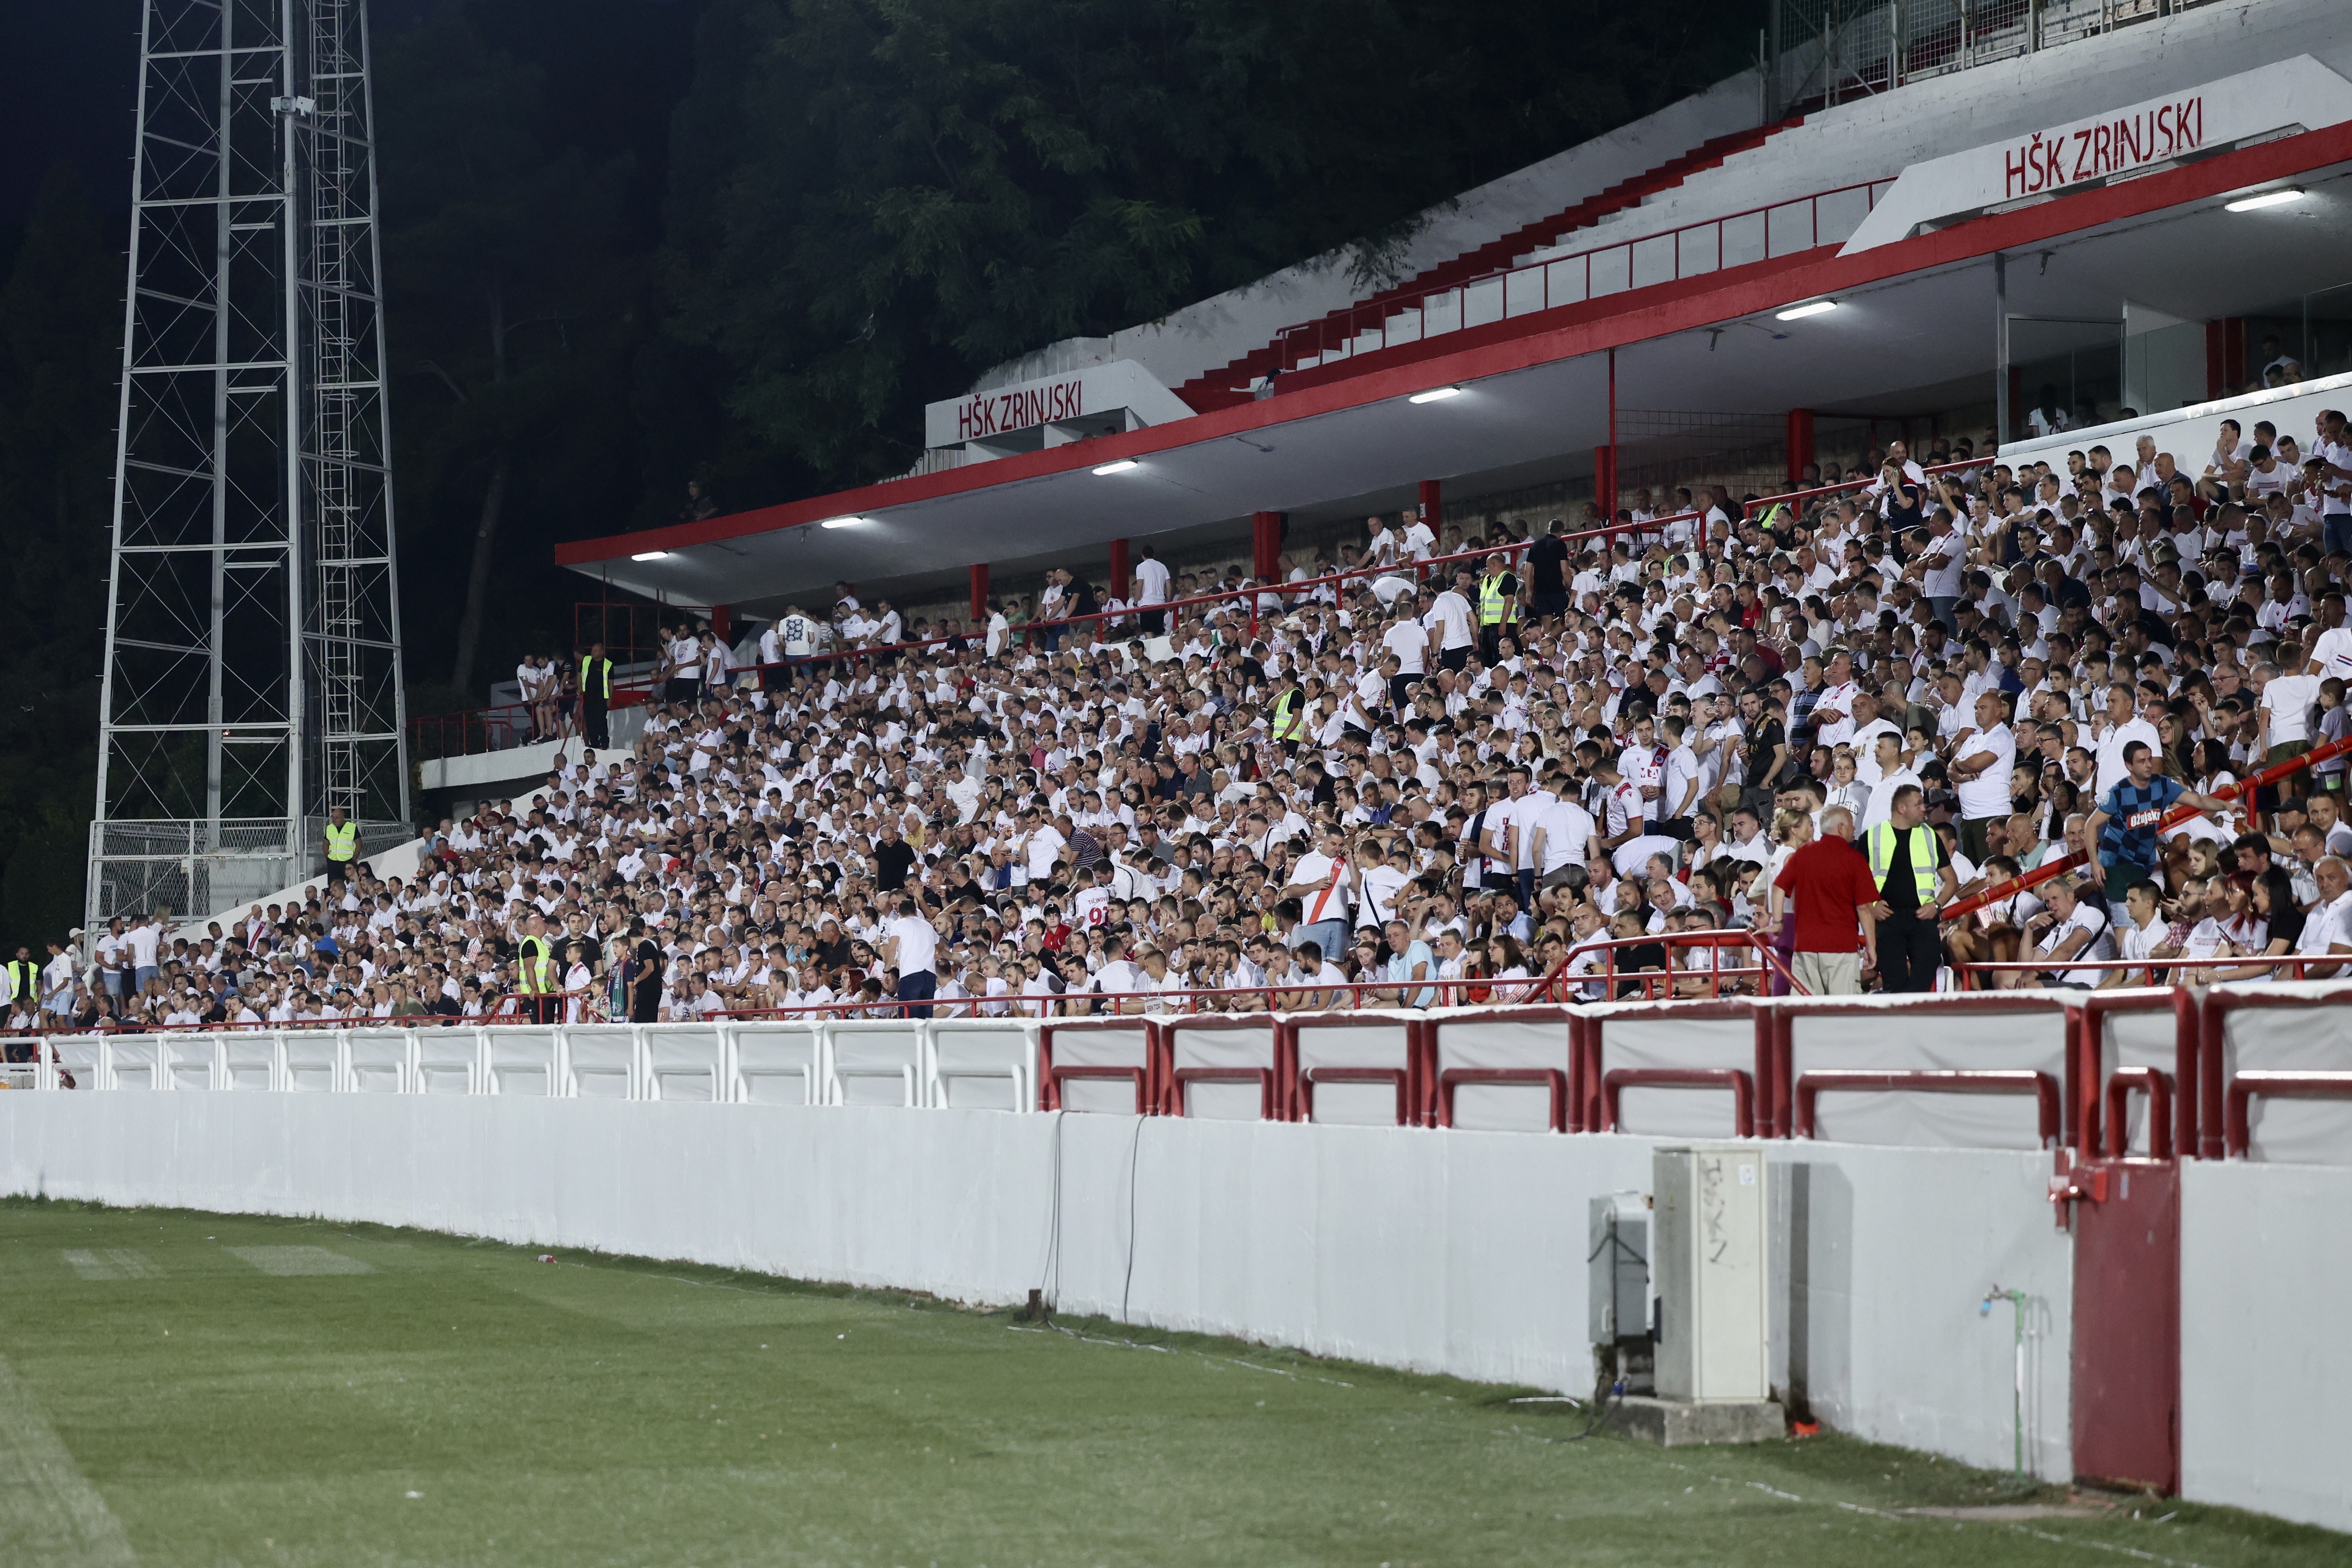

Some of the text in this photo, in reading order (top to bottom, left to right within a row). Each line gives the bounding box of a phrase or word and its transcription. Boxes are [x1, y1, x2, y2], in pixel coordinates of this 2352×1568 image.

[2006, 97, 2202, 198] HŠK ZRINJSKI
[959, 381, 1081, 439] HŠK ZRINJSKI
